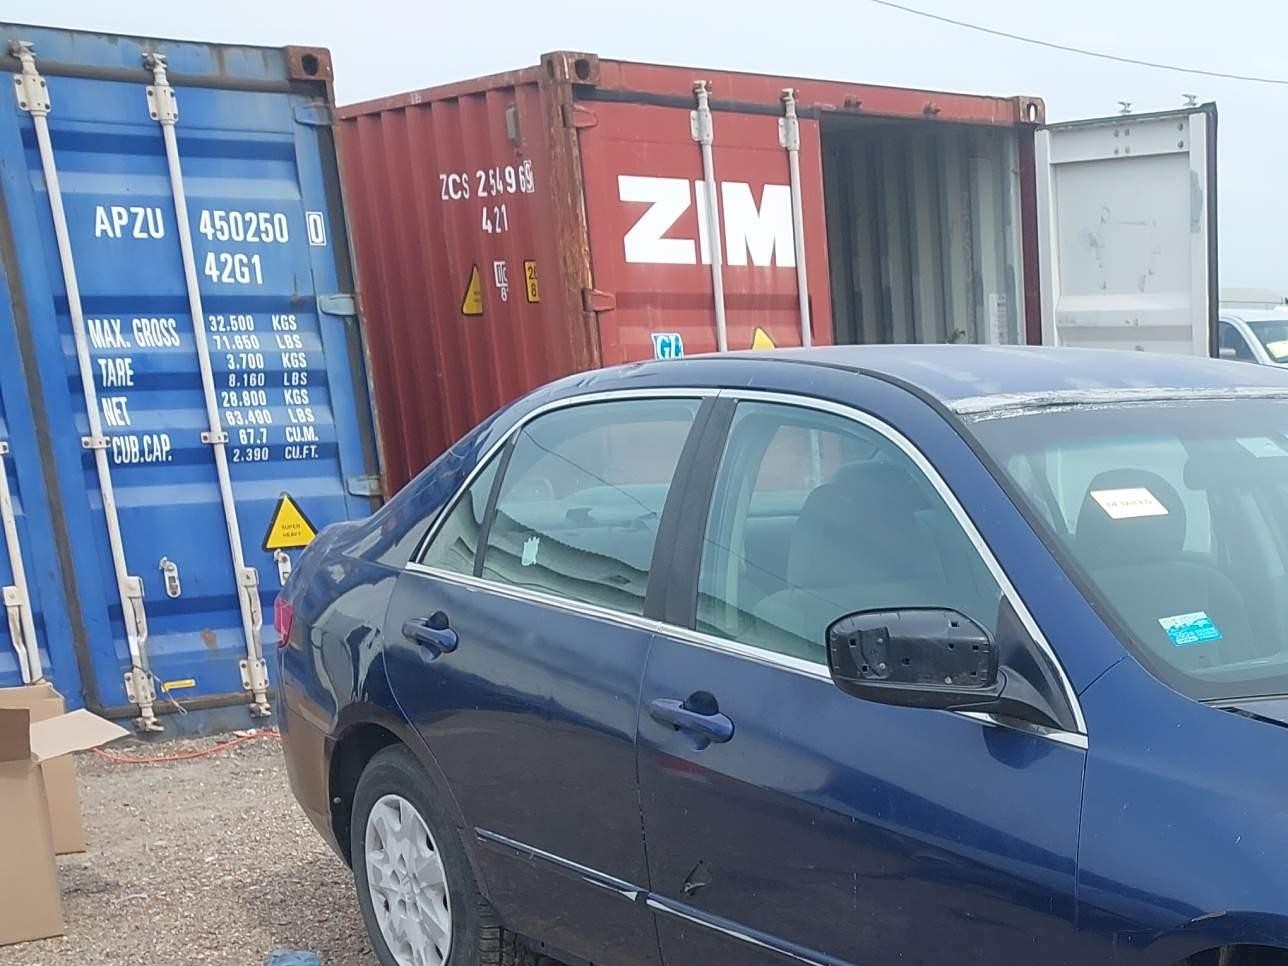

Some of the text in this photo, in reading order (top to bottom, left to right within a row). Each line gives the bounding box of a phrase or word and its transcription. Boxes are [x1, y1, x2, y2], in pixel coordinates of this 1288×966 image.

[439, 172, 470, 201] ZCS
[95, 206, 325, 245] APZU 450250 0
[617, 175, 796, 268] ZIM
[204, 252, 264, 285] 42G1
[87, 318, 181, 349] MAX. GROSS
[208, 314, 297, 332] 32.500 KGS
[275, 334, 303, 349] LBS
[97, 357, 135, 387] TARE
[281, 352, 307, 369] KGS
[283, 371, 308, 386] LBS
[221, 388, 309, 408] 28.800 KGS
[101, 396, 132, 427] NET
[287, 407, 315, 423] LBS
[239, 425, 319, 445] 67.7 CU.M.
[111, 433, 172, 464] CUB.CAP.
[233, 445, 319, 462] 2.390 CU.FT.
